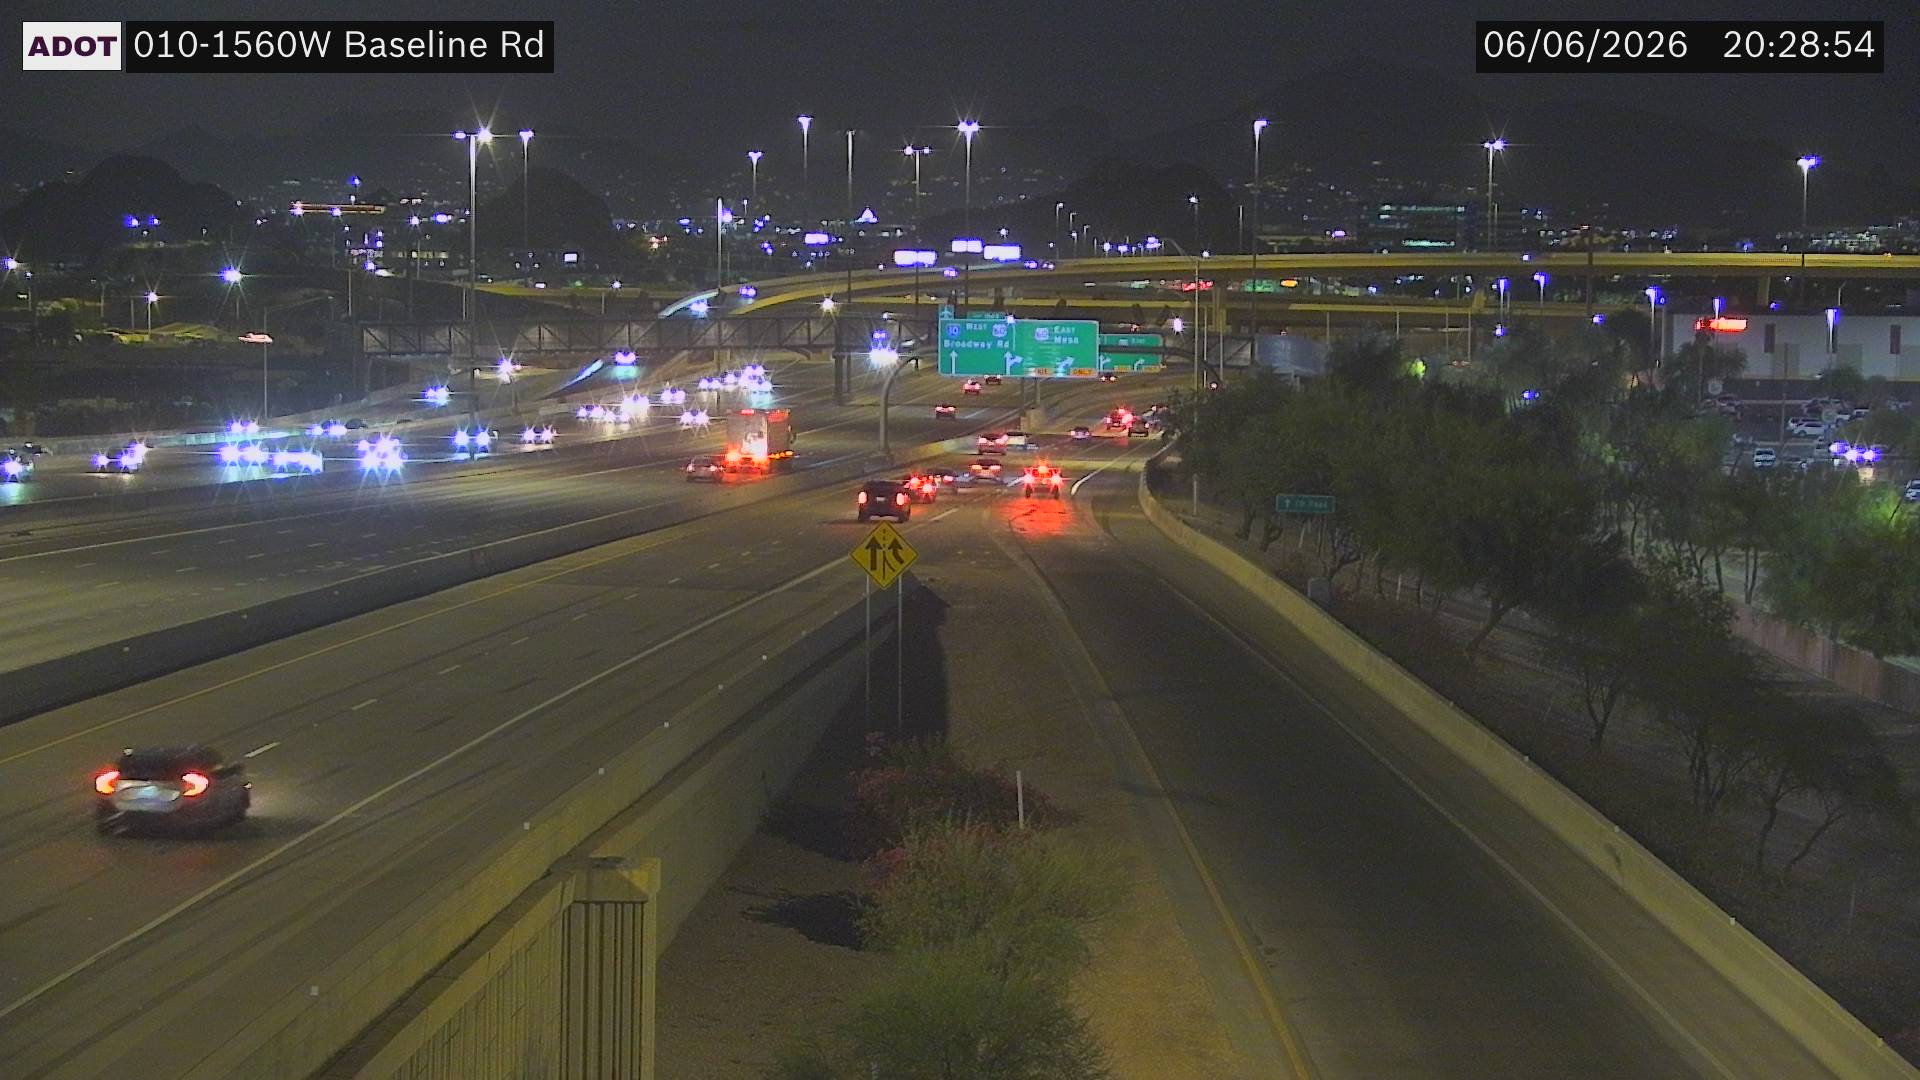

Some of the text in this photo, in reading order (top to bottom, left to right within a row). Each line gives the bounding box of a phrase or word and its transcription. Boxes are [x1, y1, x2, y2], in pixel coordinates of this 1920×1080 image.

[943, 339, 1010, 349] Broadway Rd
[1054, 335, 1079, 344] Mesa
